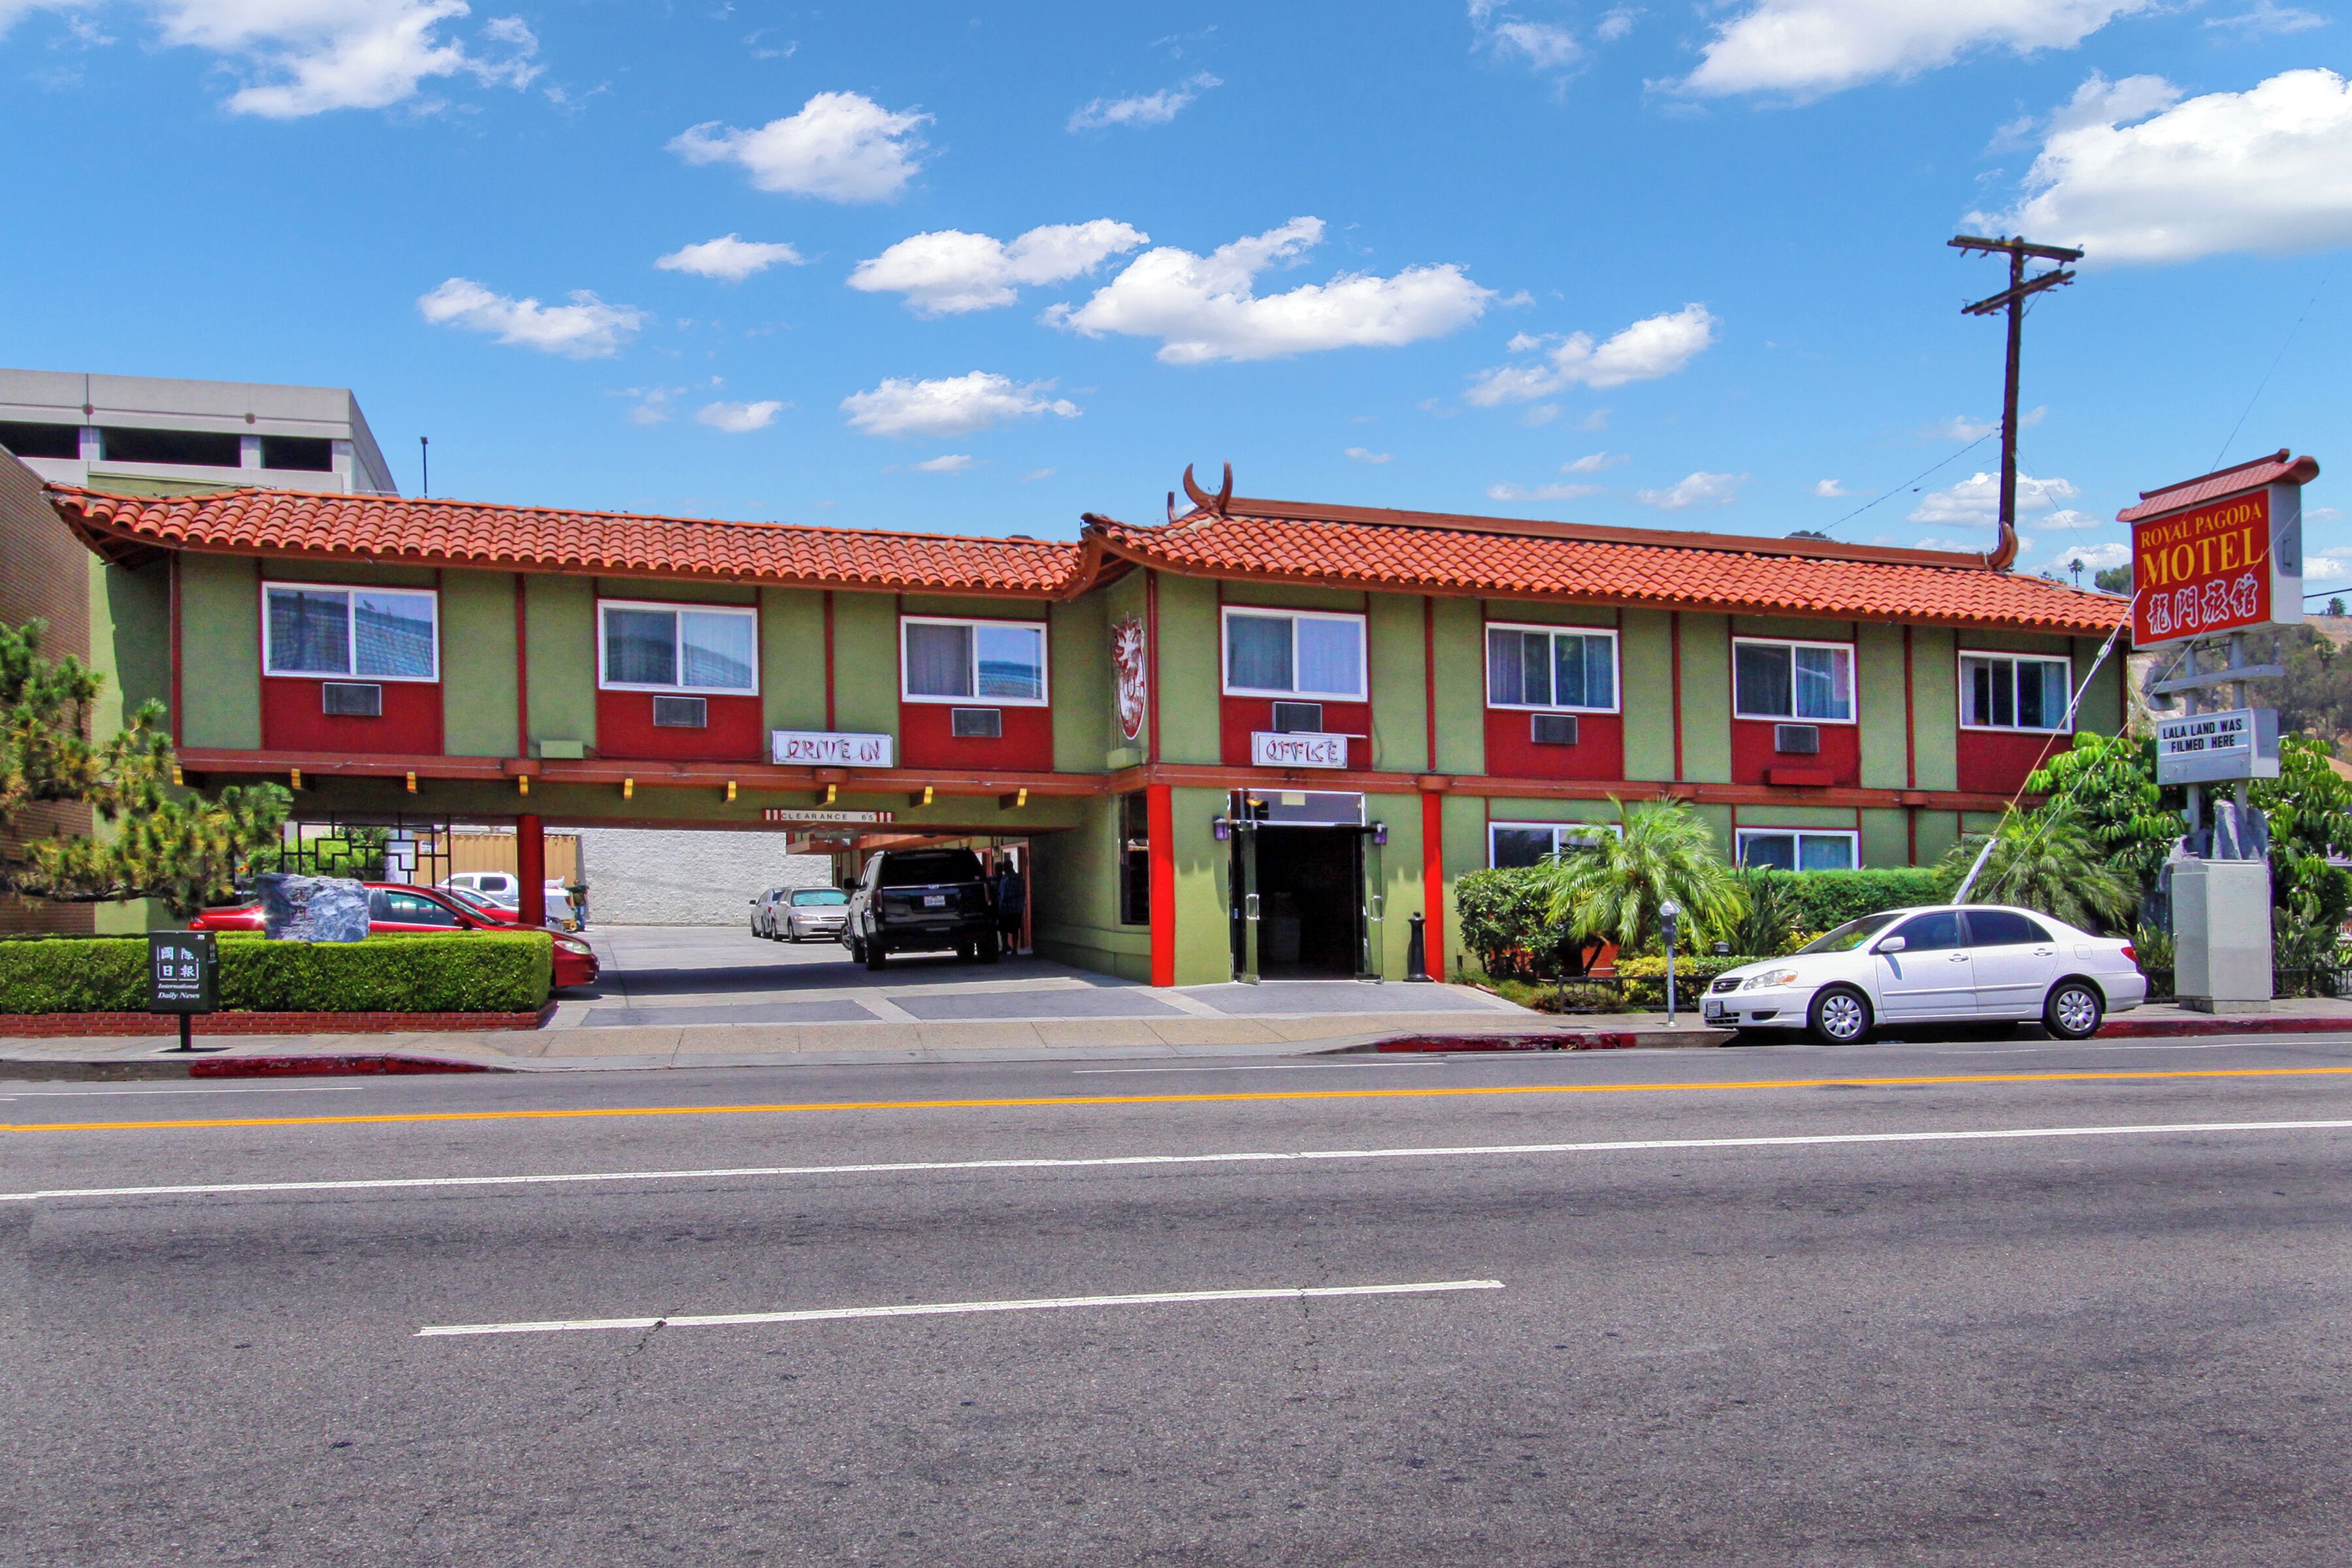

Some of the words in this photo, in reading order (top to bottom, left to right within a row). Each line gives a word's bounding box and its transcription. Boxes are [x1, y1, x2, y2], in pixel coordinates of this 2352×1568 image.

[2140, 521, 2191, 548] ROYAL
[2195, 502, 2262, 535] PAGODA
[2141, 527, 2264, 589] MOTEL
[2163, 725, 2187, 740] LALA
[2190, 721, 2215, 736] LAND
[2220, 718, 2242, 732] WAS
[787, 739, 851, 761] DRIVE
[860, 740, 880, 762] IN
[1266, 740, 1338, 763] OFFICE
[2171, 738, 2204, 753] FILMED
[2211, 734, 2235, 749] HERE
[781, 812, 847, 821] CLEARANCE
